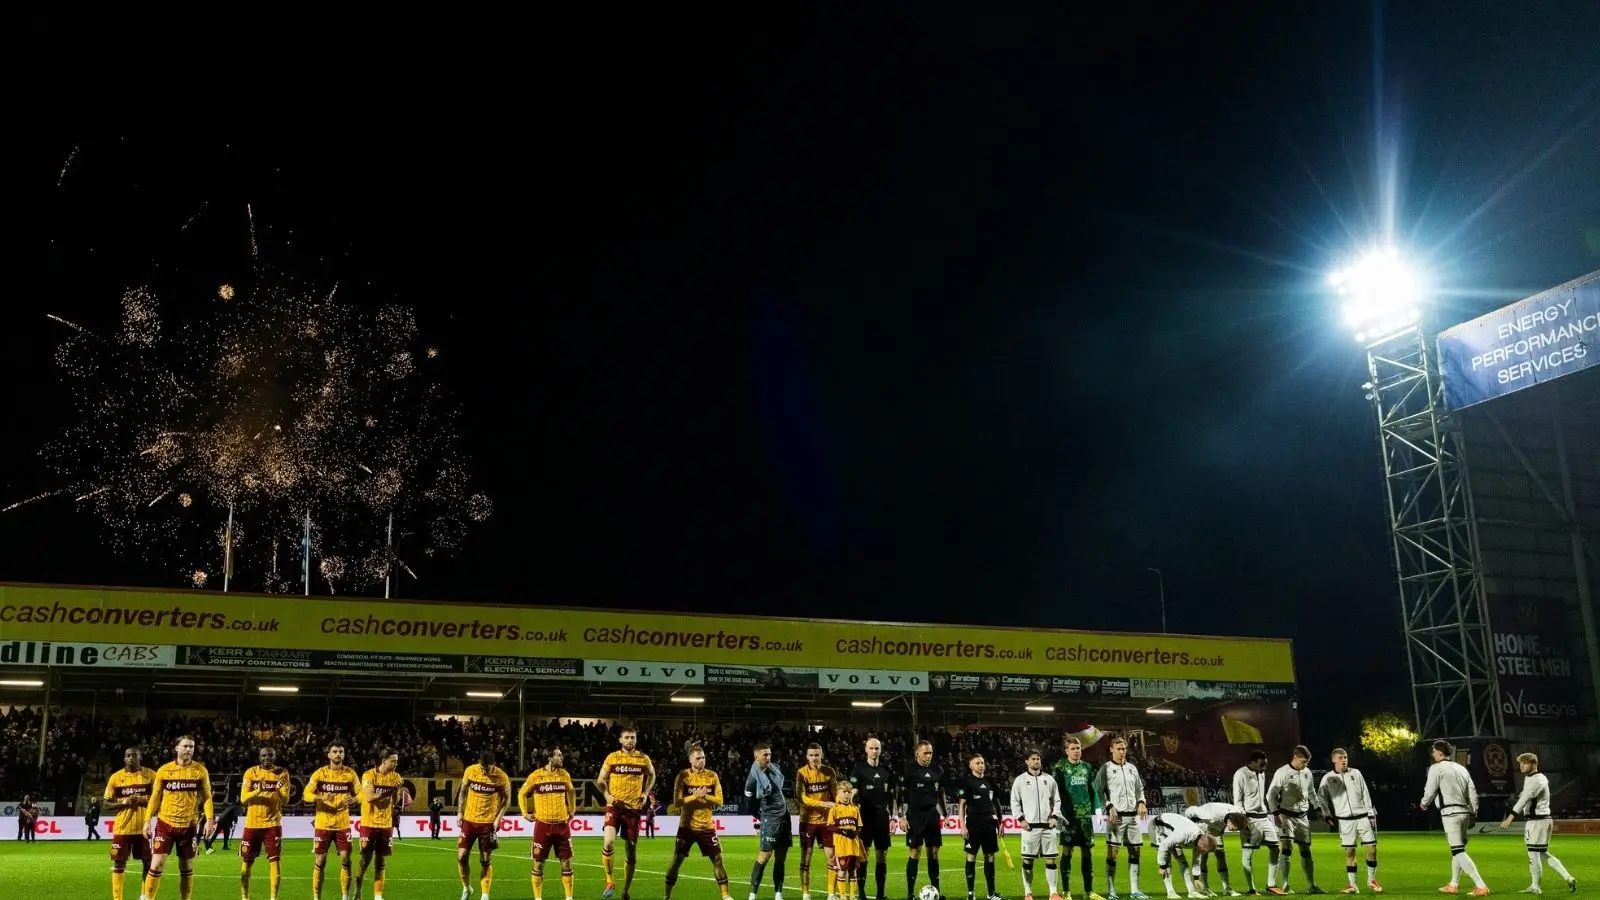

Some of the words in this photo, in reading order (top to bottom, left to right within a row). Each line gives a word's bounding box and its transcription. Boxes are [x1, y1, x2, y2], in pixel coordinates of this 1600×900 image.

[1498, 299, 1571, 339] ENERGY
[1471, 311, 1600, 371] PERFORMANC
[1497, 343, 1587, 384] SERVICES
[0, 601, 280, 631] cashconverters.co.uk
[321, 613, 567, 642] cashconverters.co.uk
[583, 624, 804, 652] cashconverters.co.uk
[1493, 633, 1541, 655] HOME
[103, 645, 160, 661] CABS
[208, 647, 243, 656] KERR
[836, 635, 1033, 660] cashconverters.co.uk
[1045, 643, 1224, 666] cashconverters.co.uk
[247, 659, 310, 668] CONTRACTORS
[484, 657, 515, 665] KERR
[1497, 656, 1571, 677] STEELMEN
[484, 666, 534, 674] ELECTRICAL
[535, 667, 577, 675] SERVICES
[592, 666, 697, 678] VOLVO
[827, 674, 920, 686] VOLVO
[34, 820, 62, 834] CL
[500, 819, 523, 831] CL
[570, 819, 593, 831] CL
[1003, 818, 1022, 829] CL
